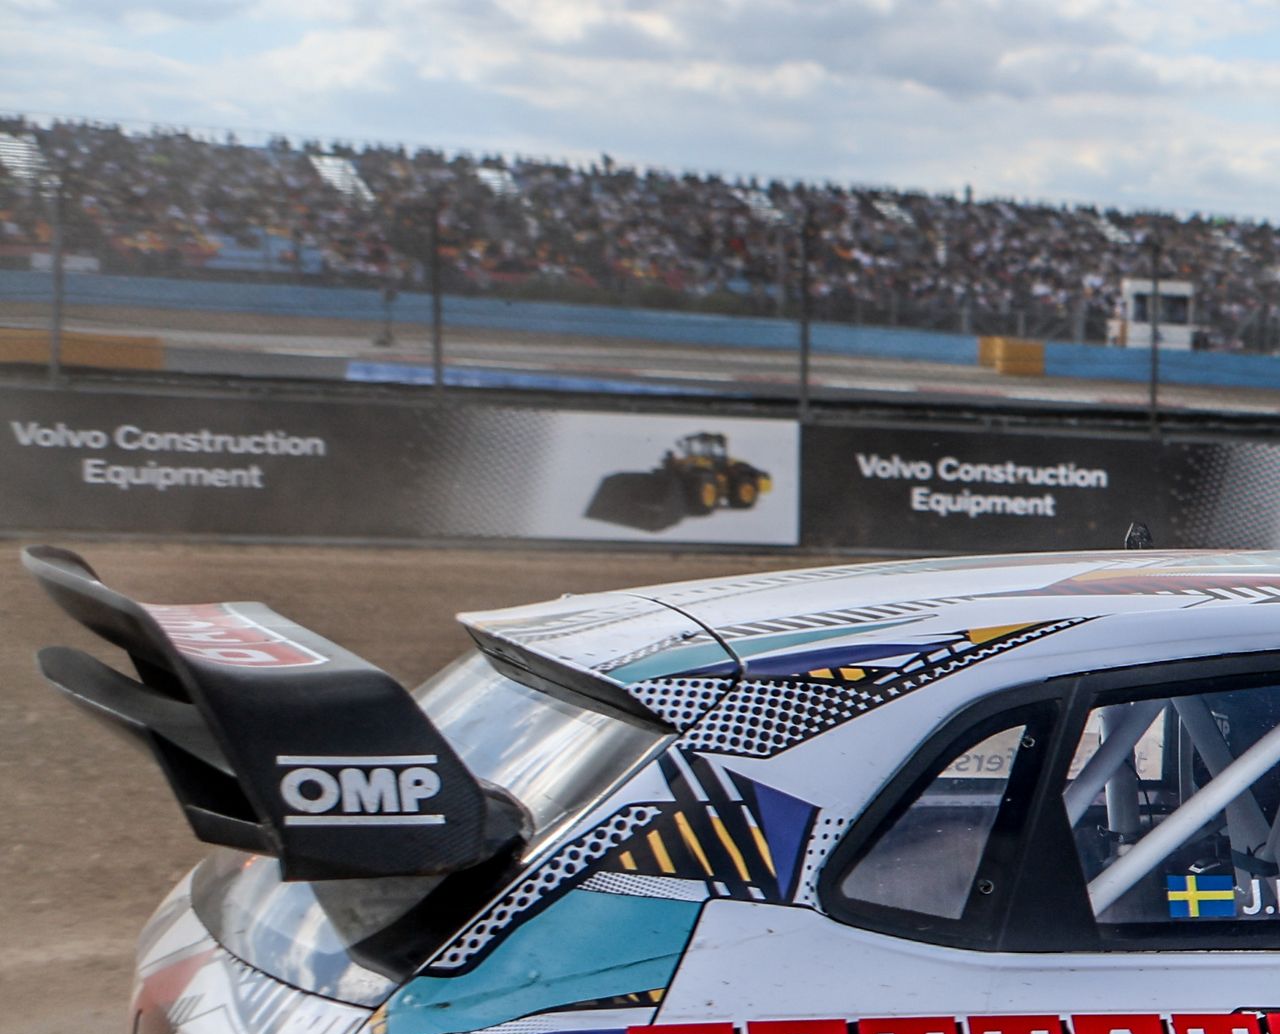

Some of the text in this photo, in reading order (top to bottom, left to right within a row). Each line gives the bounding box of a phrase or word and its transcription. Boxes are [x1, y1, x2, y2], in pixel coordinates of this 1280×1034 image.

[11, 421, 326, 456] Volvo Construction
[81, 458, 265, 490] Equipment
[856, 453, 1109, 488] Volvo Construction
[910, 486, 1056, 518] Equipment
[280, 766, 442, 813] OMP
